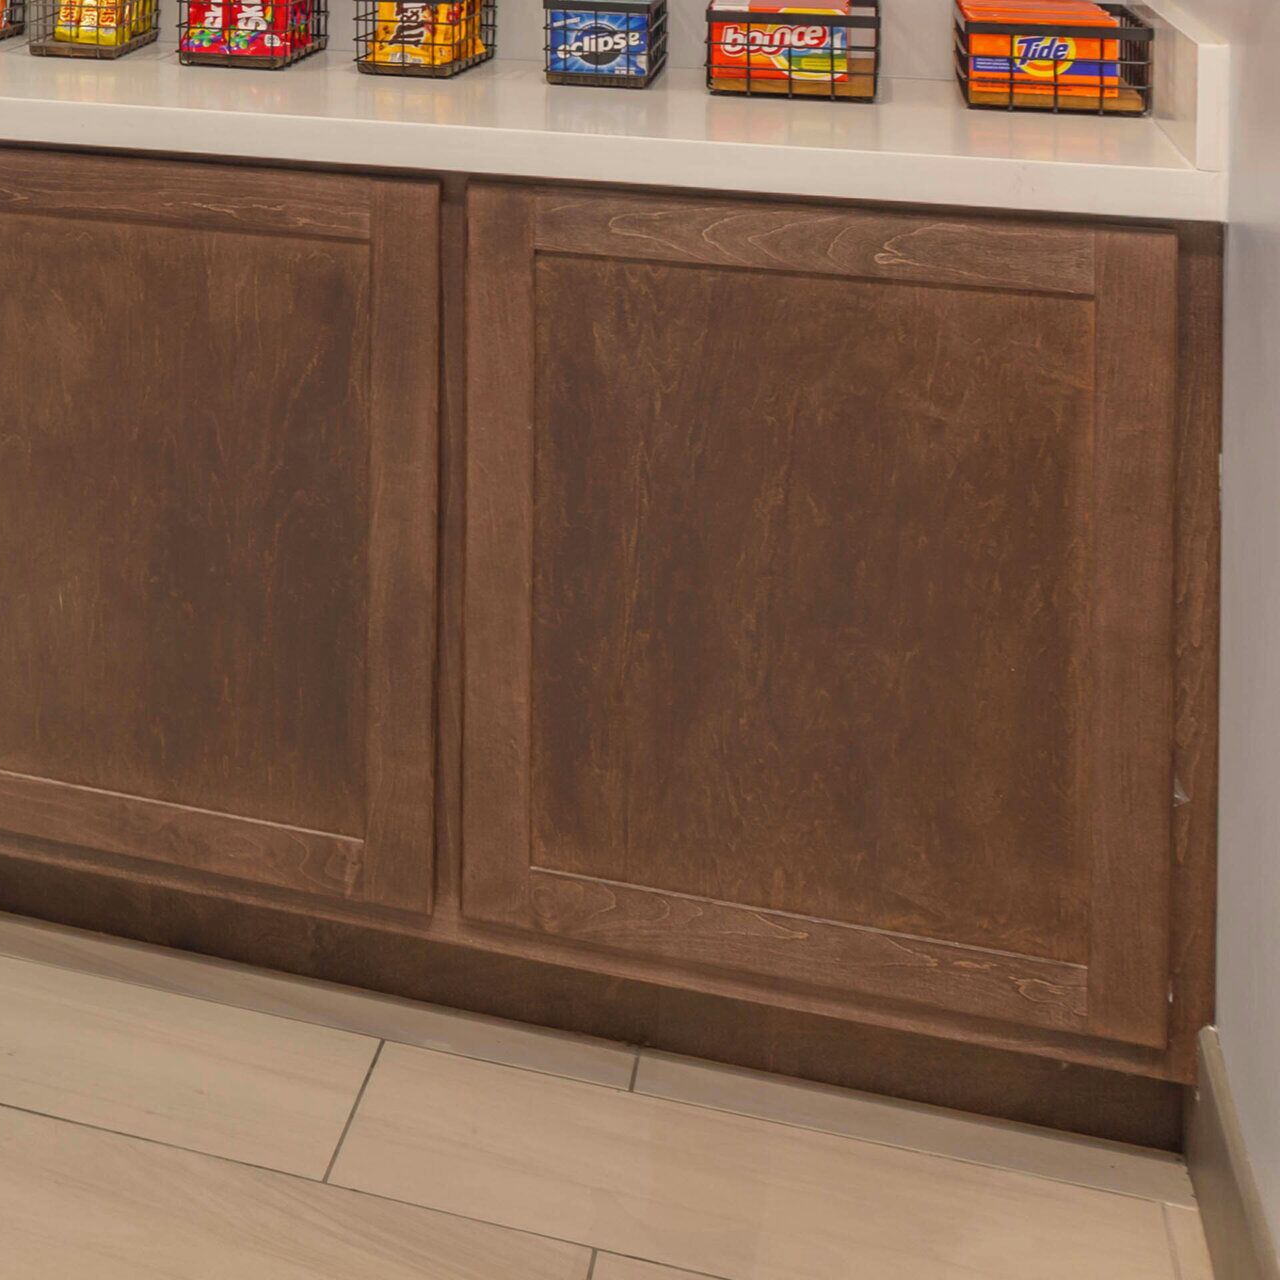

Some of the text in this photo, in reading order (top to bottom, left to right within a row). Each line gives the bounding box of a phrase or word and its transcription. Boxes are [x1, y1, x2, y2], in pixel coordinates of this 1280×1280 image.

[557, 31, 640, 59] eclipse
[724, 24, 827, 55] bounce
[1017, 36, 1070, 67] Tide
